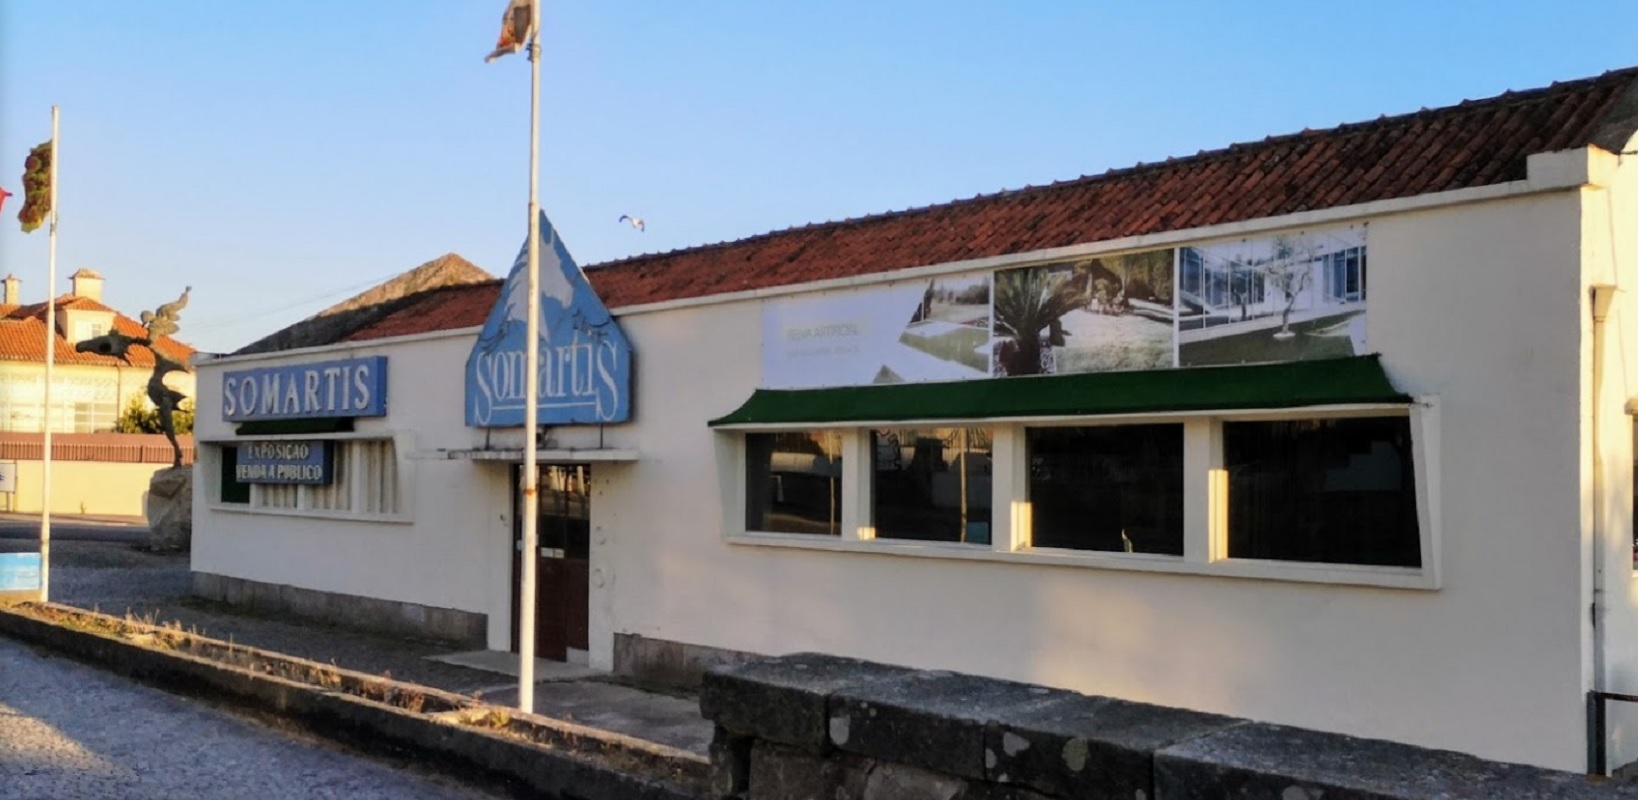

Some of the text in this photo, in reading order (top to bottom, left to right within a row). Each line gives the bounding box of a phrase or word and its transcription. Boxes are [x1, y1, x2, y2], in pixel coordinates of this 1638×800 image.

[224, 365, 370, 416] SOMARTIS
[236, 464, 267, 479] VENDA
[268, 464, 275, 479] A
